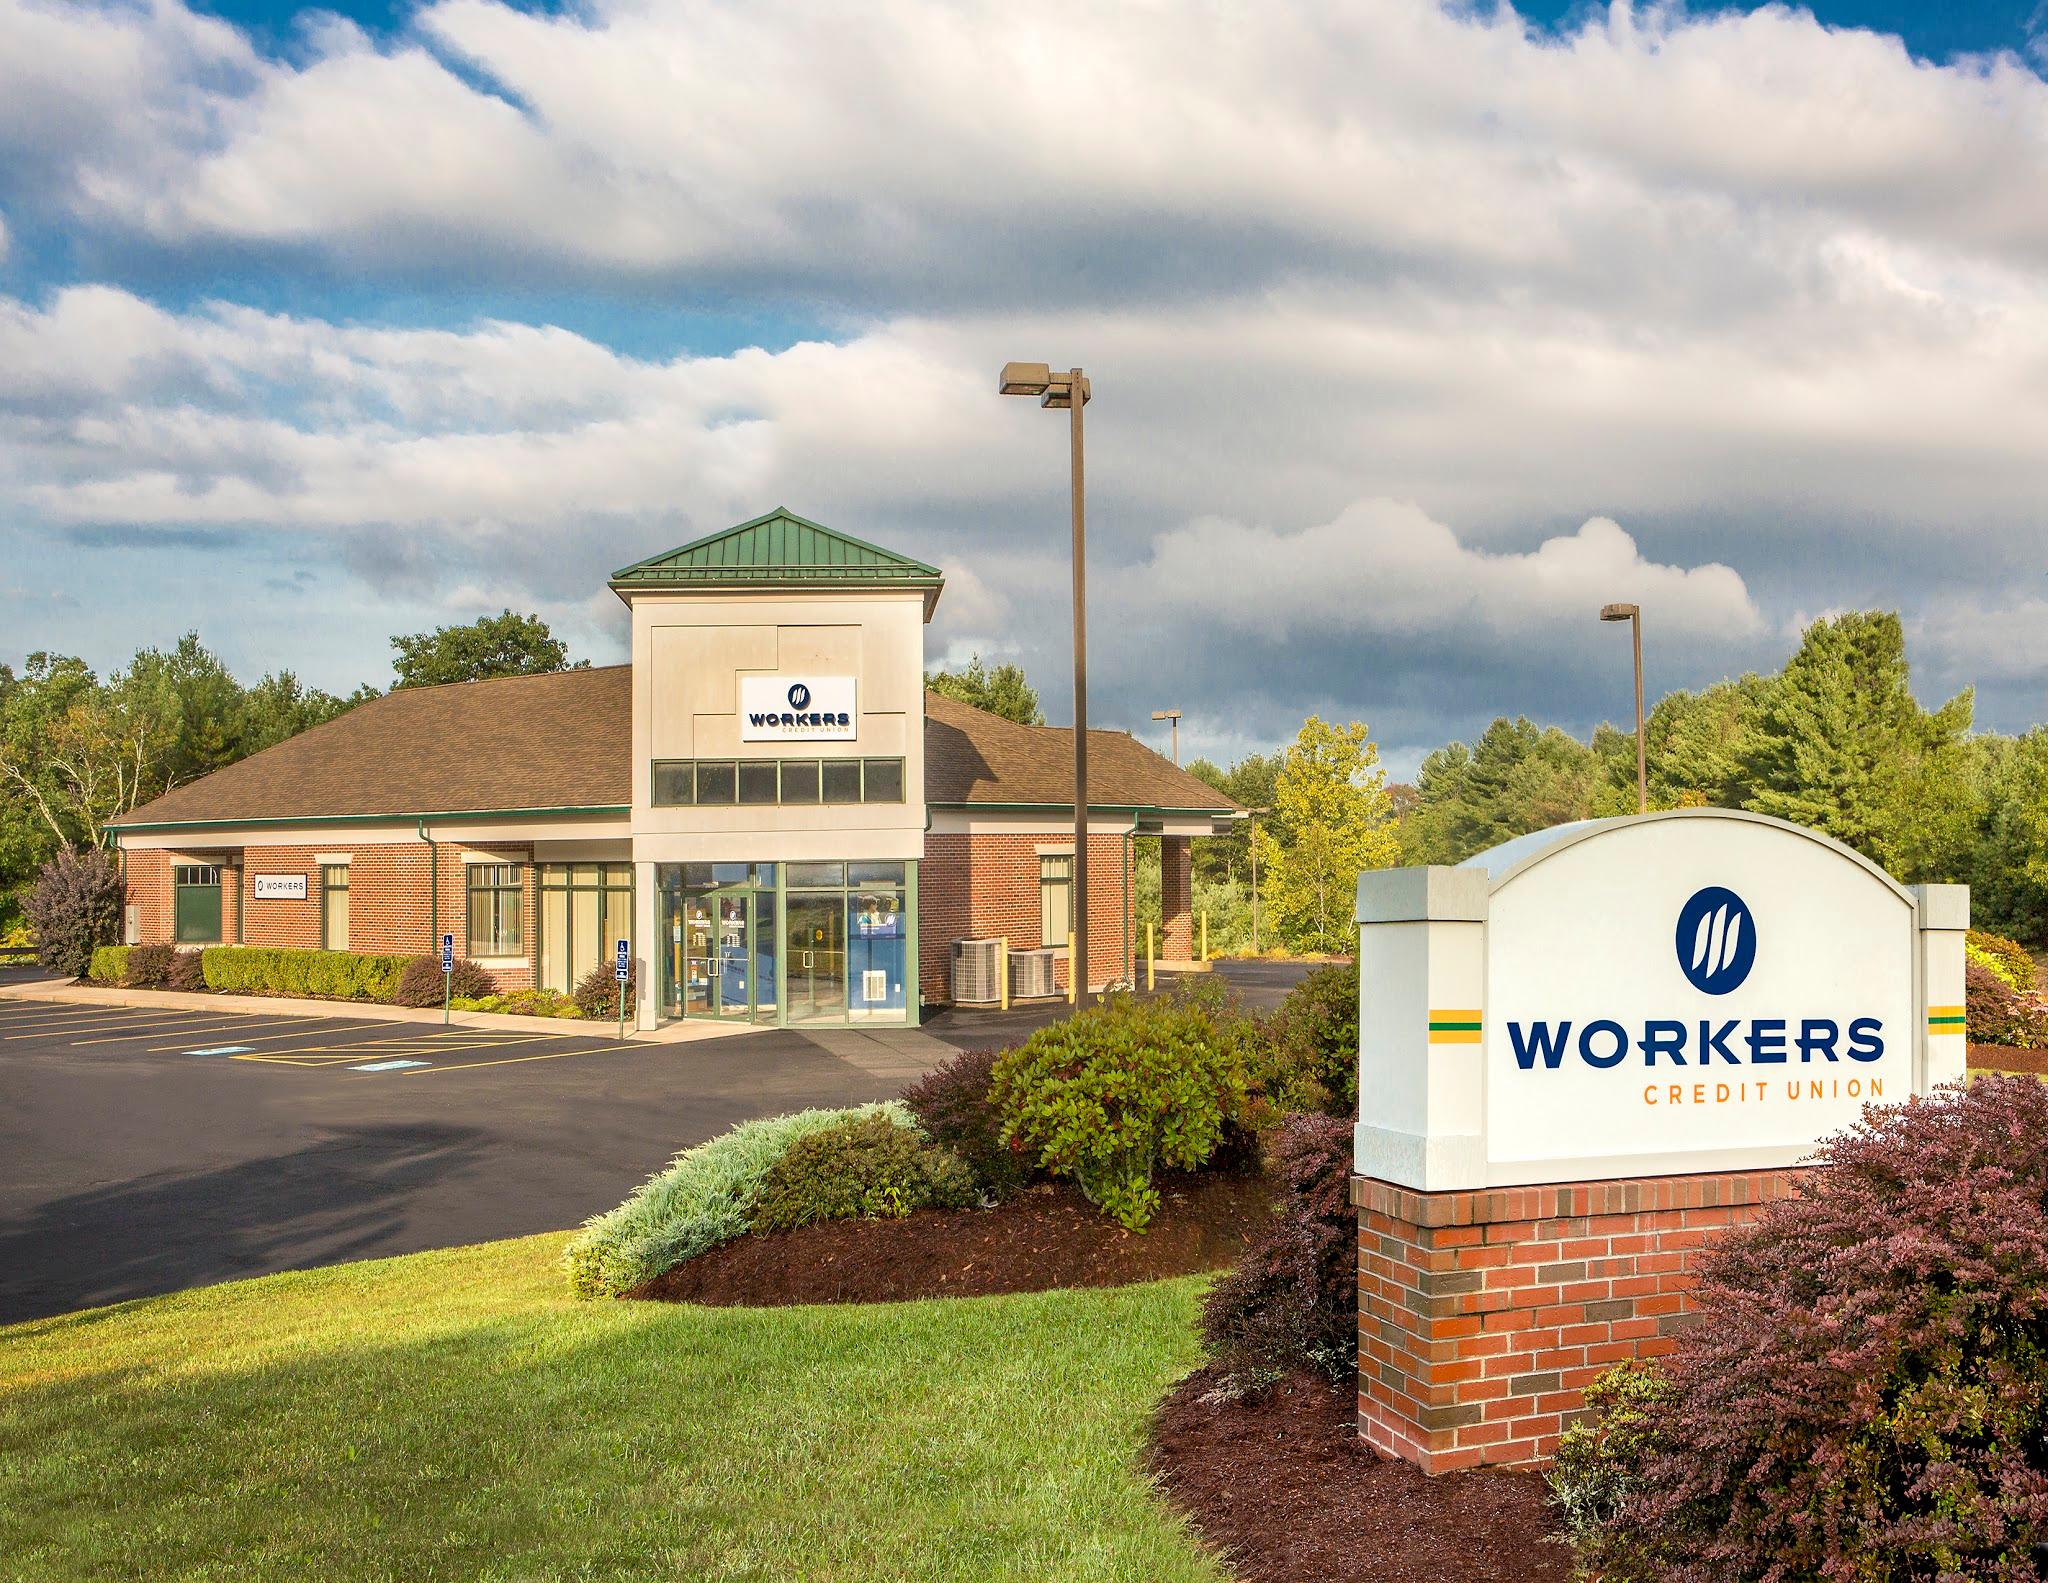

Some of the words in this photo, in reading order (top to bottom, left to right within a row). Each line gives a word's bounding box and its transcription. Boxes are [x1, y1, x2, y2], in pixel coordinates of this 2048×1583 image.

[749, 713, 850, 727] WORKERS
[266, 882, 304, 890] WORKERS
[1507, 1017, 1885, 1070] WORKERS
[1643, 1081, 1769, 1106] CREDIT
[1787, 1078, 1885, 1102] UNION
